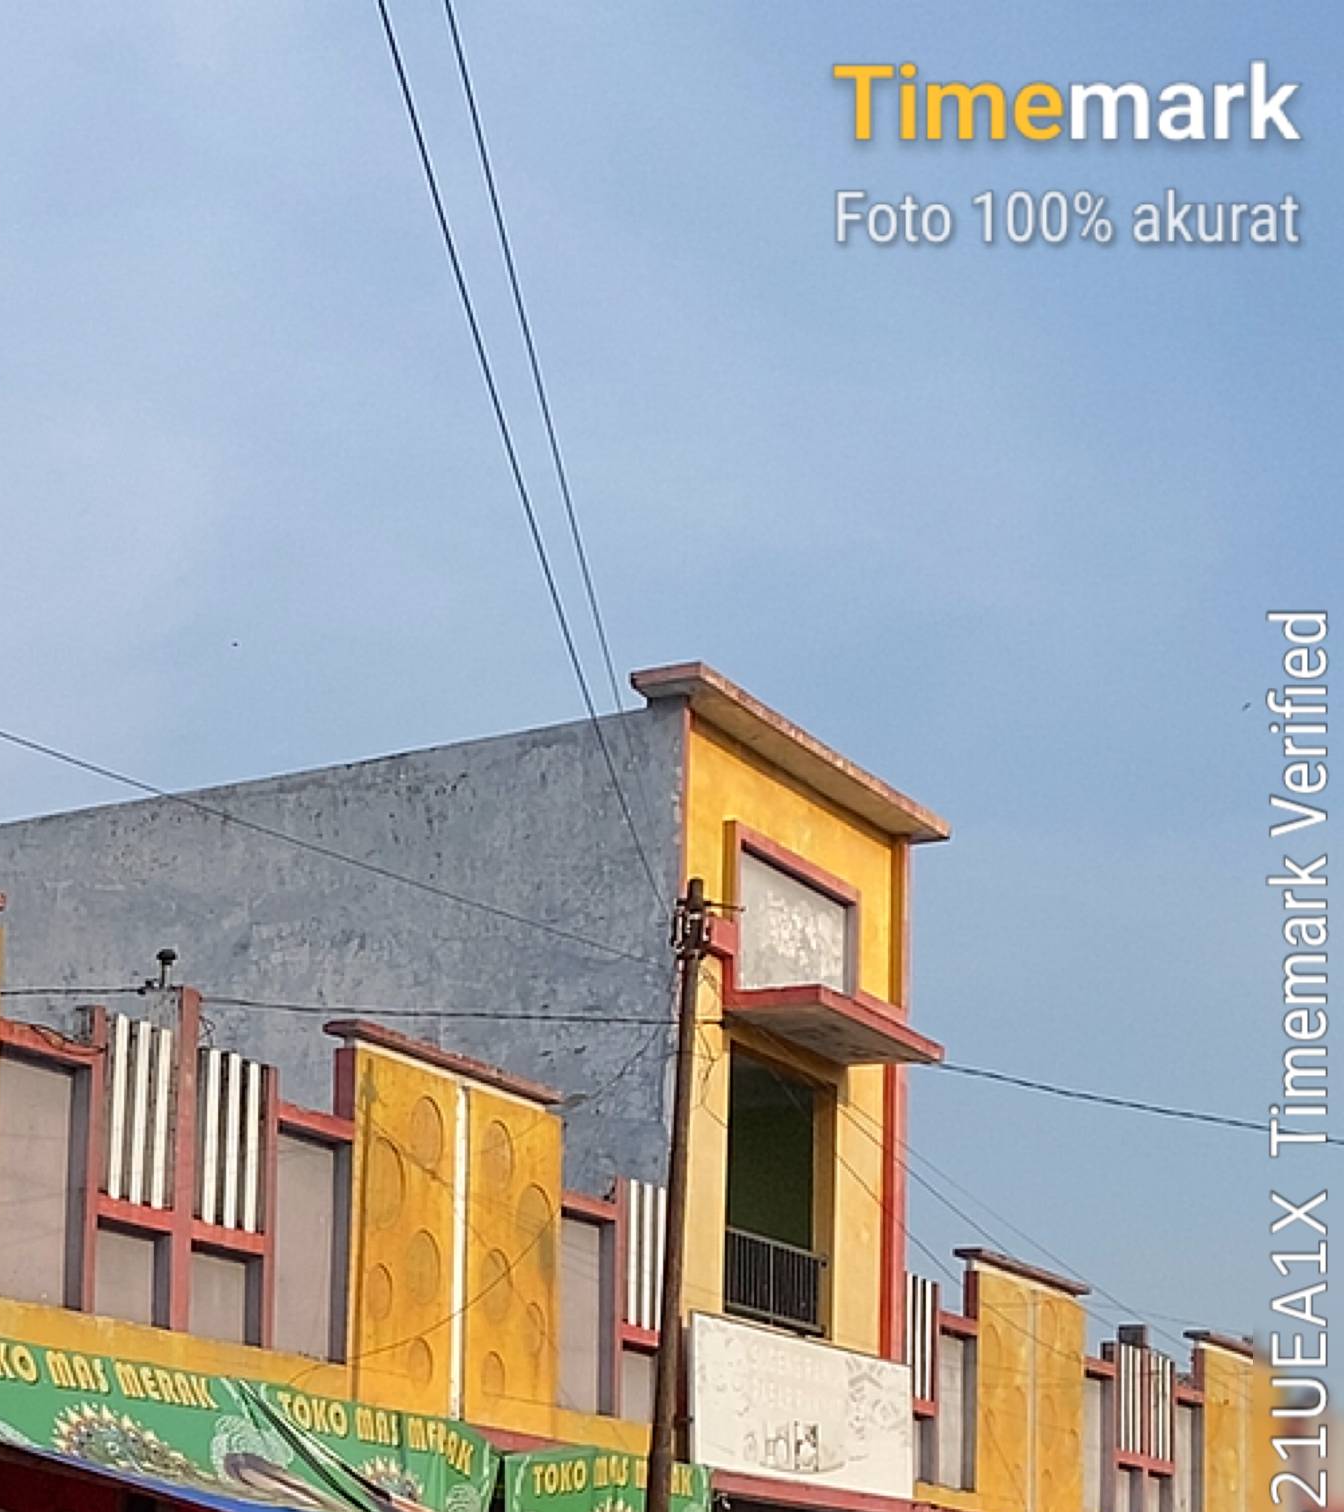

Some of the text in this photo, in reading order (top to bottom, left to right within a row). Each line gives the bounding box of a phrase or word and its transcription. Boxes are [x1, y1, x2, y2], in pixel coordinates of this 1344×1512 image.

[44, 1349, 111, 1395] MAS
[113, 1358, 220, 1411] MERAK
[275, 1391, 349, 1439] TOKO
[532, 1459, 588, 1498] TOKO
